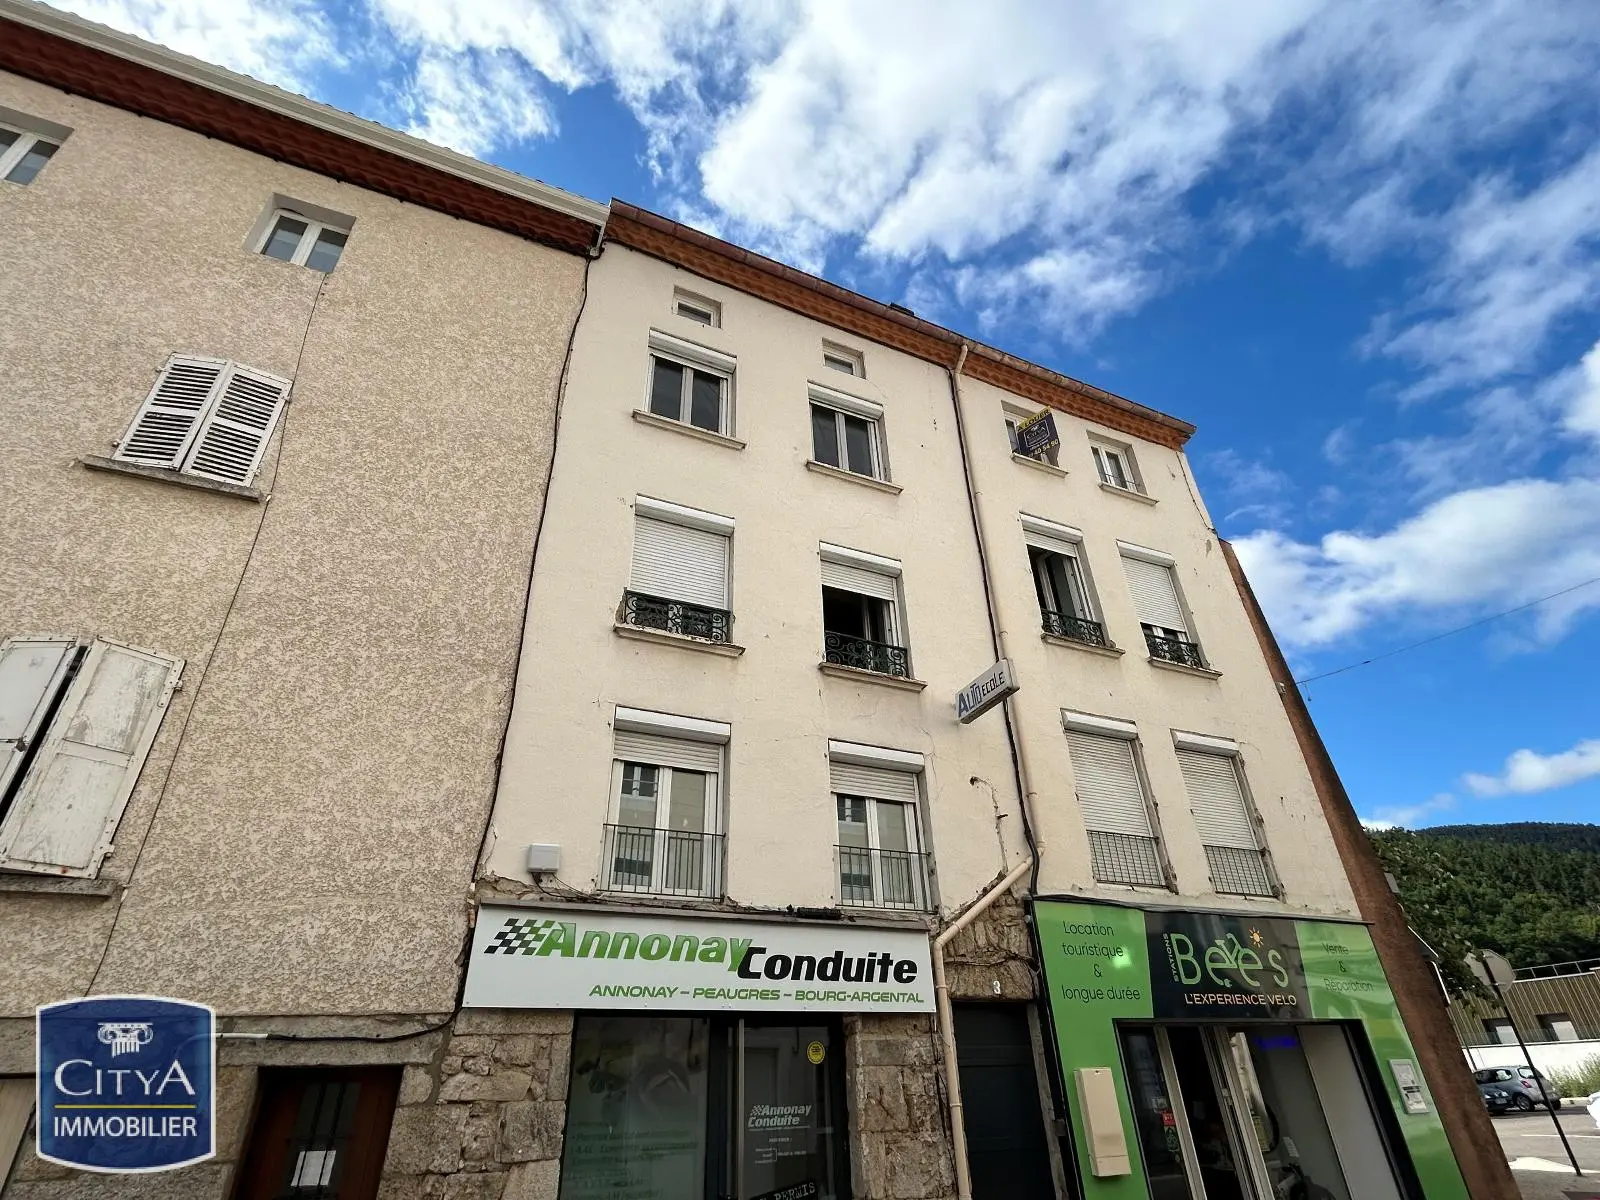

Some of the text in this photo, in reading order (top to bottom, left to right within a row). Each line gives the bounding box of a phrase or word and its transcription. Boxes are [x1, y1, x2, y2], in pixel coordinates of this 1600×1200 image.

[1063, 921, 1114, 937] Location
[536, 922, 751, 972] Annonay
[1062, 942, 1124, 959] touristique
[1322, 943, 1349, 956] Vente
[737, 947, 917, 983] Conduite
[1093, 964, 1103, 977] &
[1338, 960, 1347, 973] &
[1324, 977, 1375, 994] Réparation
[589, 984, 679, 999] ANNONAY
[693, 987, 781, 1001] PEAUGRES
[795, 990, 925, 1004] BOURG-ARGENTAL
[1062, 985, 1141, 1004] longue durée
[1185, 992, 1297, 1007] L'EXPERIENCE VELO
[760, 1104, 812, 1116] Annonay
[748, 1115, 800, 1127] Conduite
